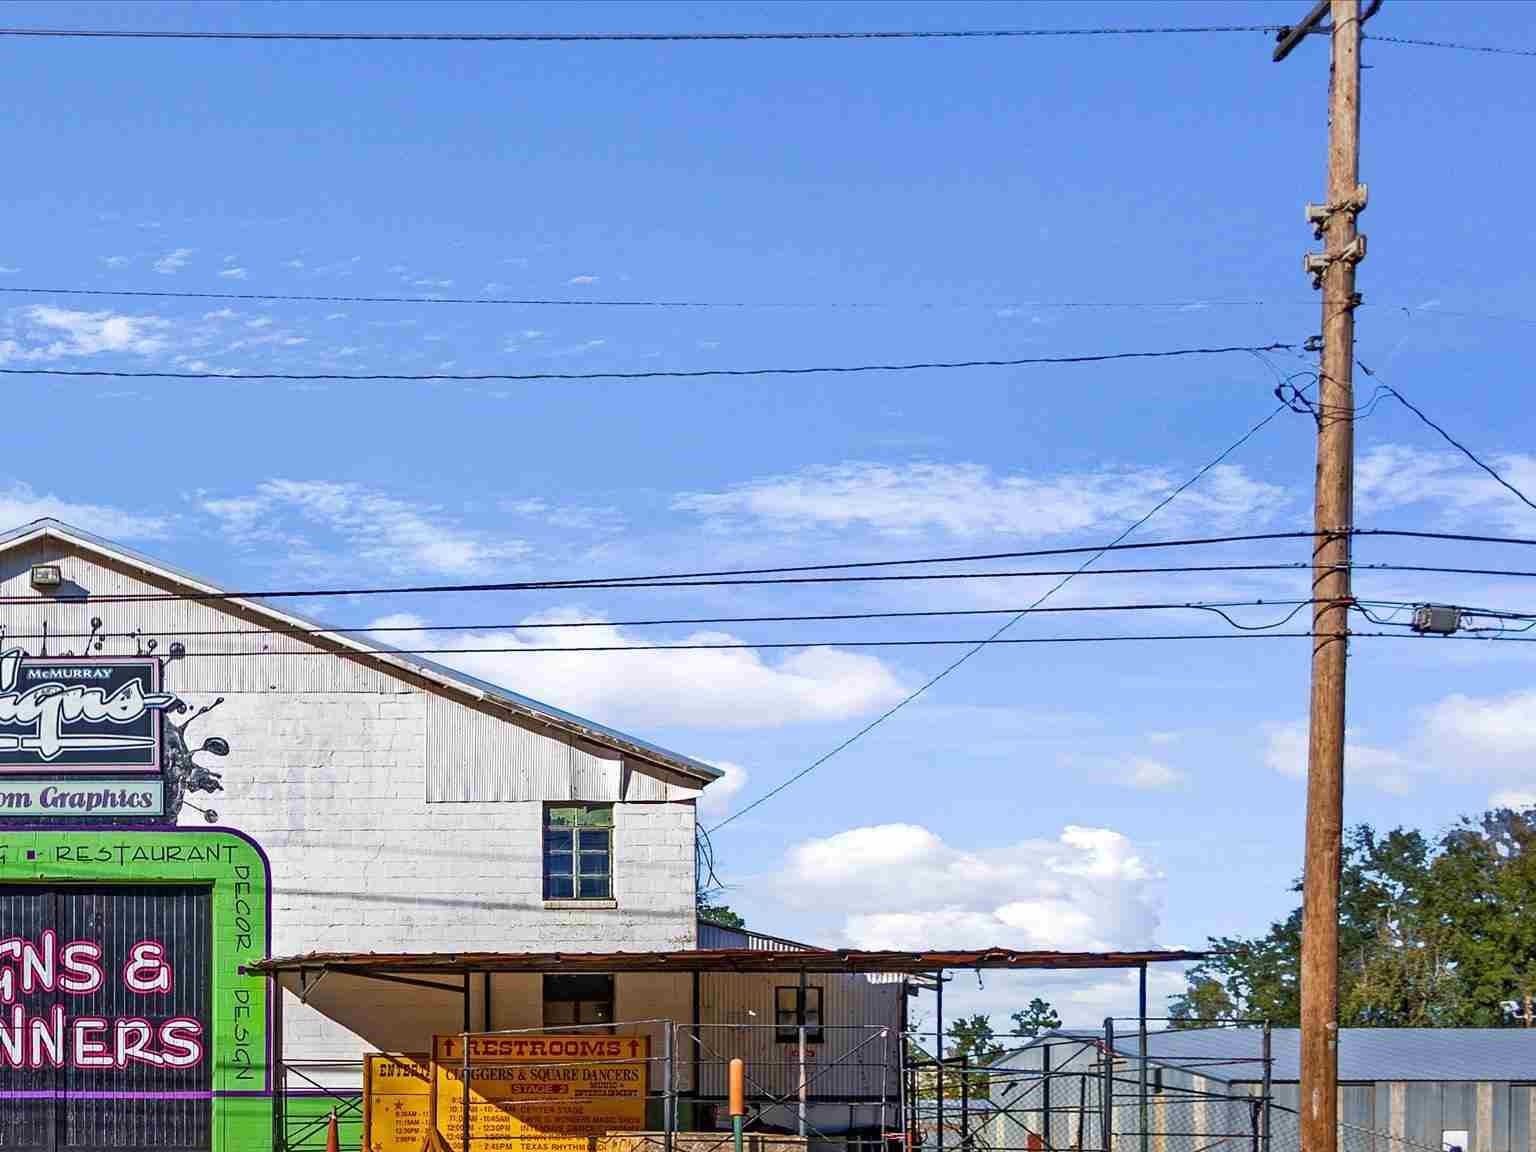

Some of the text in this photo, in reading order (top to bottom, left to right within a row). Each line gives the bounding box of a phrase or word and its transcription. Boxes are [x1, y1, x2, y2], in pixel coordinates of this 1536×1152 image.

[27, 667, 113, 679] McMURRAY
[39, 785, 153, 812] Graphics
[56, 843, 240, 863] RESTAURANT
[234, 865, 252, 953] DECOR
[123, 940, 173, 993] &
[232, 989, 254, 1080] DESIGN
[518, 1069, 528, 1081] &
[529, 1066, 576, 1082] SQUARE
[582, 1068, 639, 1081] DANCERS
[520, 1143, 549, 1151] TEXAS
